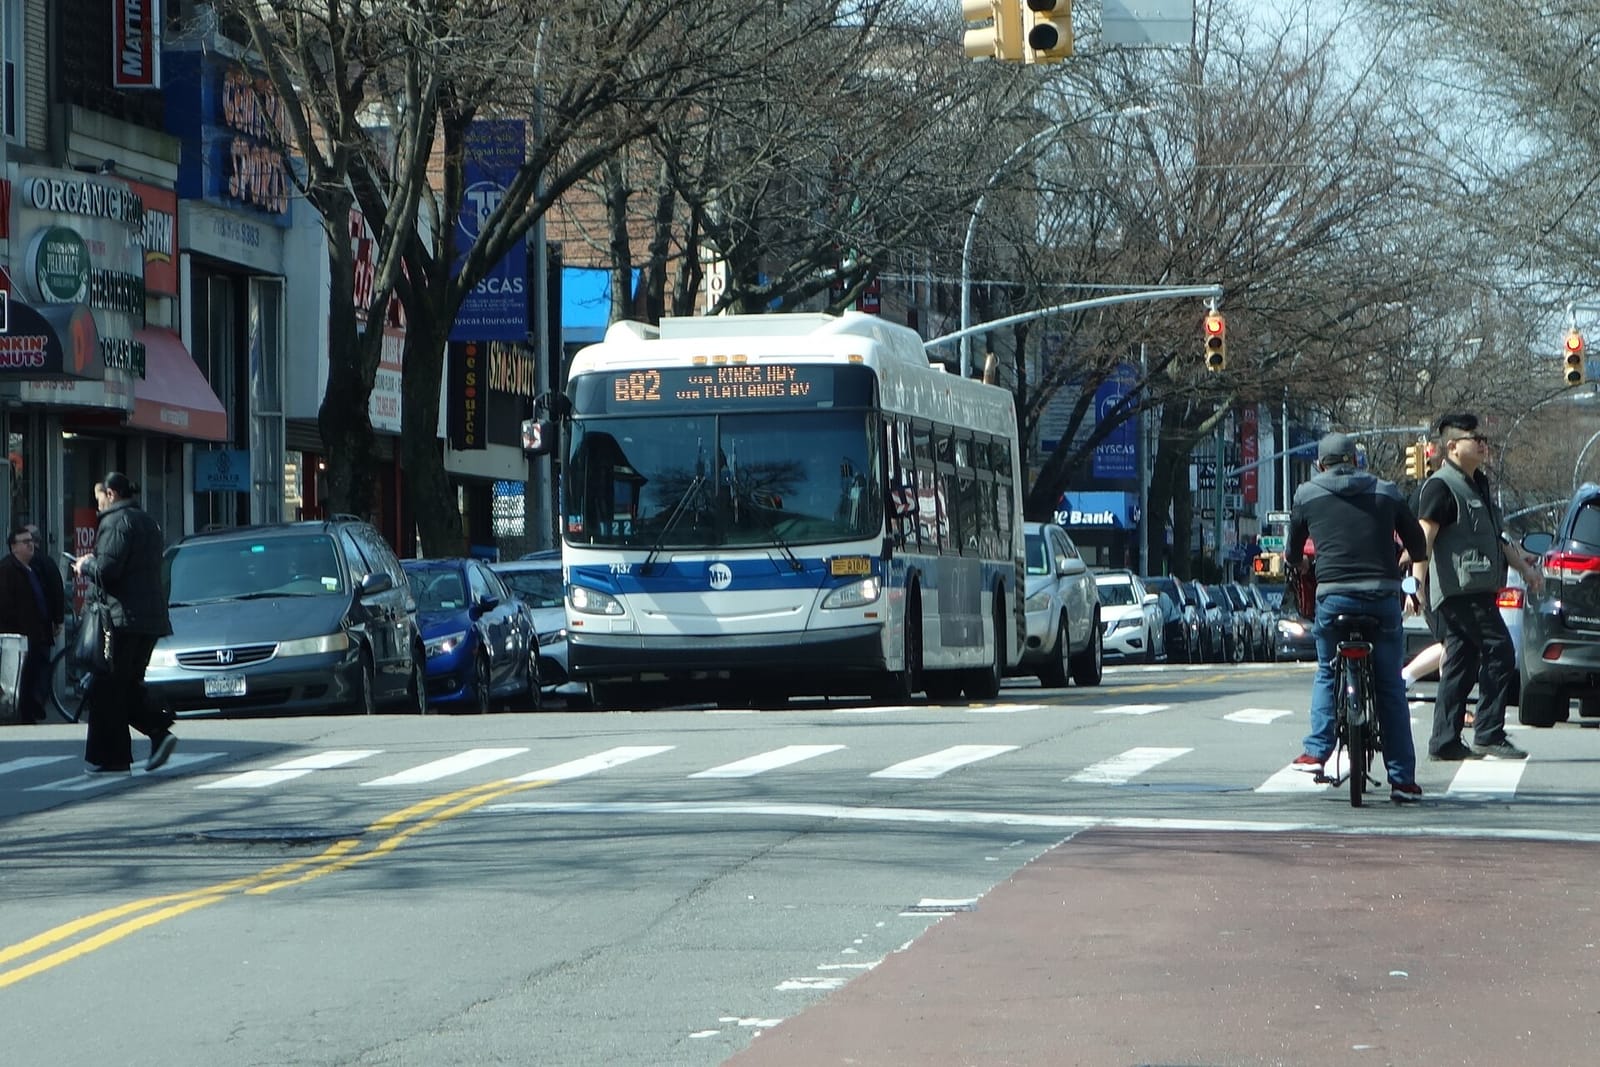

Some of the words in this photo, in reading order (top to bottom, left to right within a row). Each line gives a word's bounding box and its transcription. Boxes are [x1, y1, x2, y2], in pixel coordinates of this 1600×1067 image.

[32, 178, 119, 219] ORGANIC
[470, 277, 523, 293] SCAS
[0, 352, 45, 367] NUTS
[488, 341, 535, 397] ShoeSourc
[615, 370, 661, 401] B82
[718, 367, 761, 383] KINGS
[767, 366, 797, 382] HWY
[705, 383, 785, 398] FLATLANDS
[790, 382, 810, 396] AV
[463, 341, 478, 446] oeSource
[1095, 444, 1136, 456] NYSCAS
[1070, 510, 1114, 524] Bank
[76, 527, 95, 546] TOP
[609, 562, 632, 575] 7137
